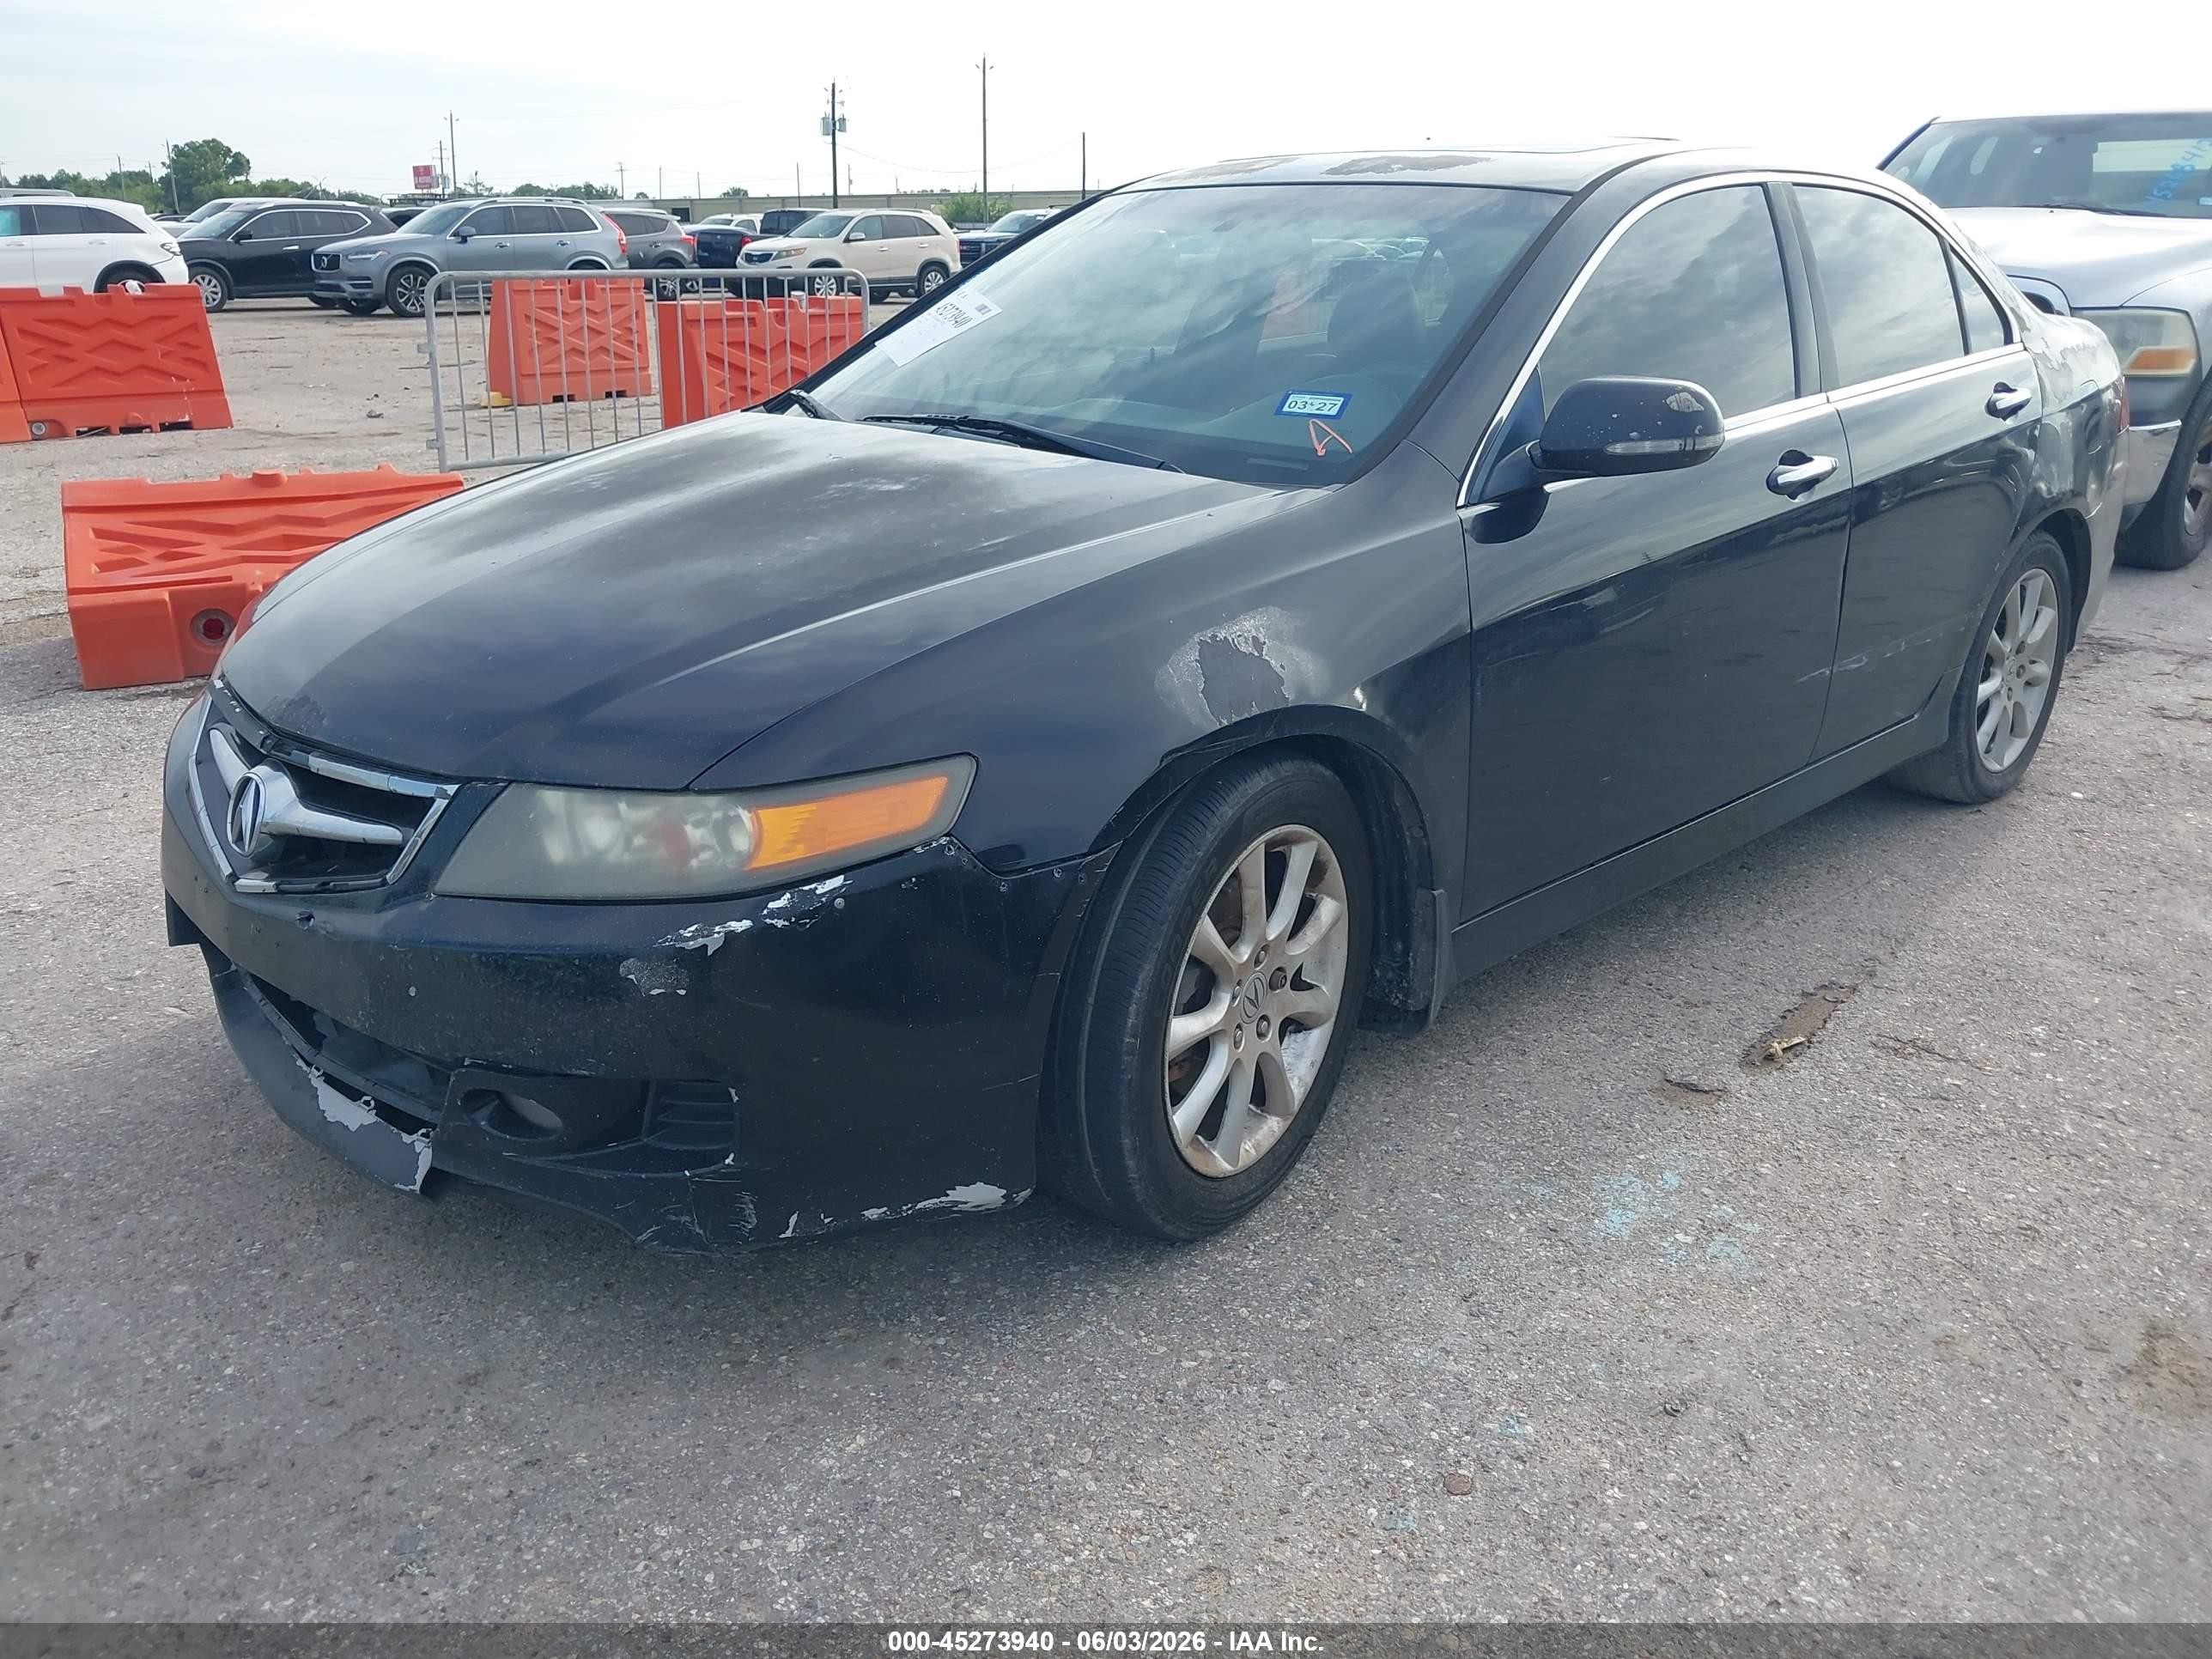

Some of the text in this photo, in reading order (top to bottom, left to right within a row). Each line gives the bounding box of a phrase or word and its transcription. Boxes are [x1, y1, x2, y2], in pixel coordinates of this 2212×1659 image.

[936, 302, 974, 329] 45273940
[1287, 400, 1338, 411] 03 27
